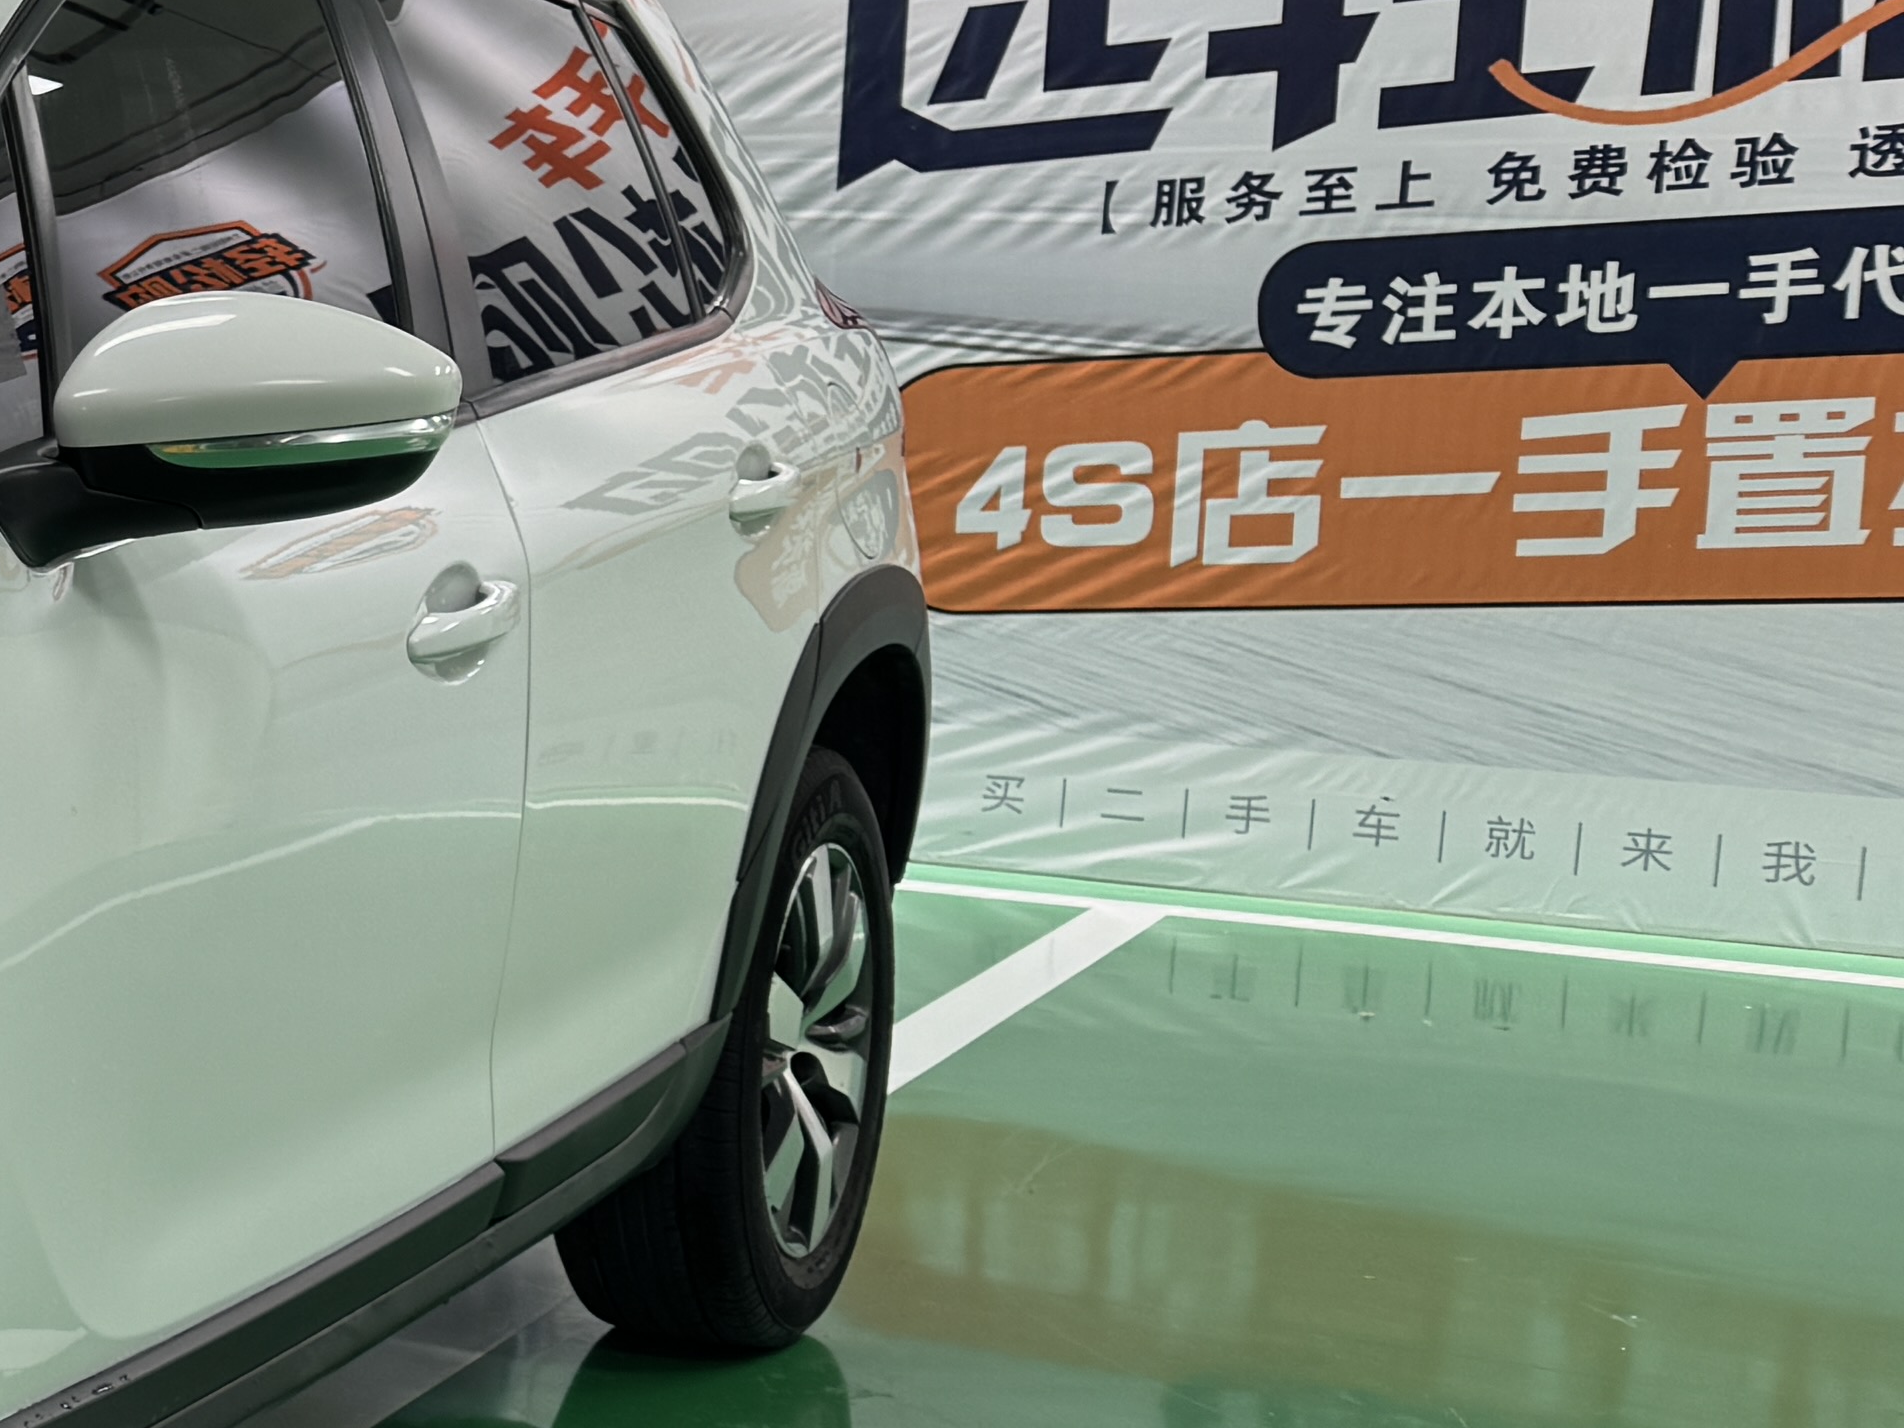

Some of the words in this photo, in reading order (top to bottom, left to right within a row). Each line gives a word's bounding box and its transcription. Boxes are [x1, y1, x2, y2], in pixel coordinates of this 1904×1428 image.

[1487, 131, 1798, 204] 免费检验
[955, 397, 1904, 568] 4S店一手置
